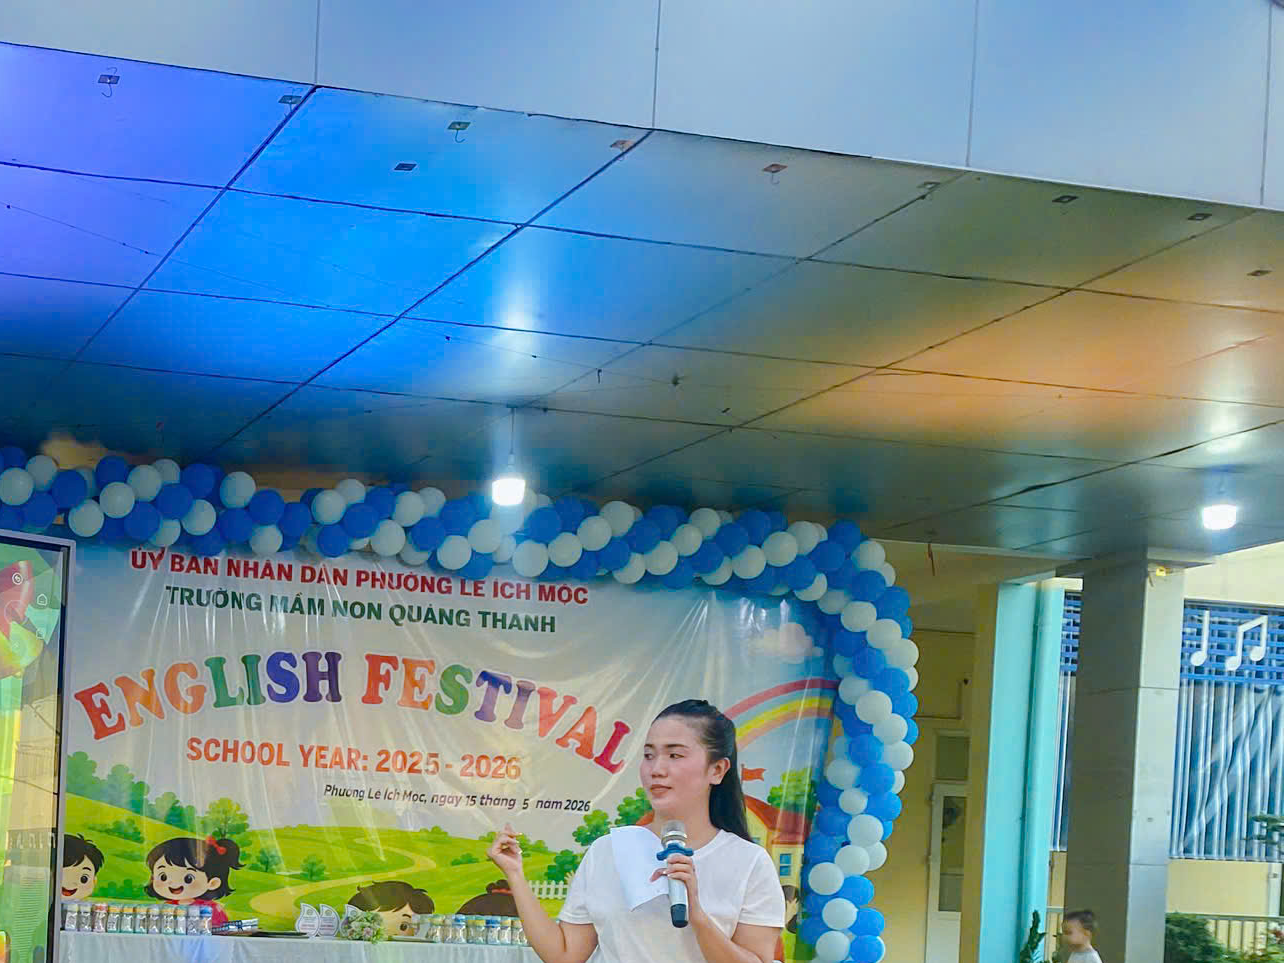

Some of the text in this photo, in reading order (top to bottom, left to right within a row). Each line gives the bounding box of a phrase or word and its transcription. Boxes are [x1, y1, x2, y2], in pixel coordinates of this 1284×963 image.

[170, 554, 219, 576] BAN
[332, 600, 382, 621] NON
[478, 610, 556, 633] THANH
[74, 651, 631, 775] ENGLISH FESTIVAL
[187, 736, 290, 767] SCHOOL
[298, 743, 369, 770] YEAR:
[375, 749, 440, 776] 2025
[459, 753, 522, 779] 2026
[522, 798, 530, 810] 5
[564, 799, 591, 812] 2026
